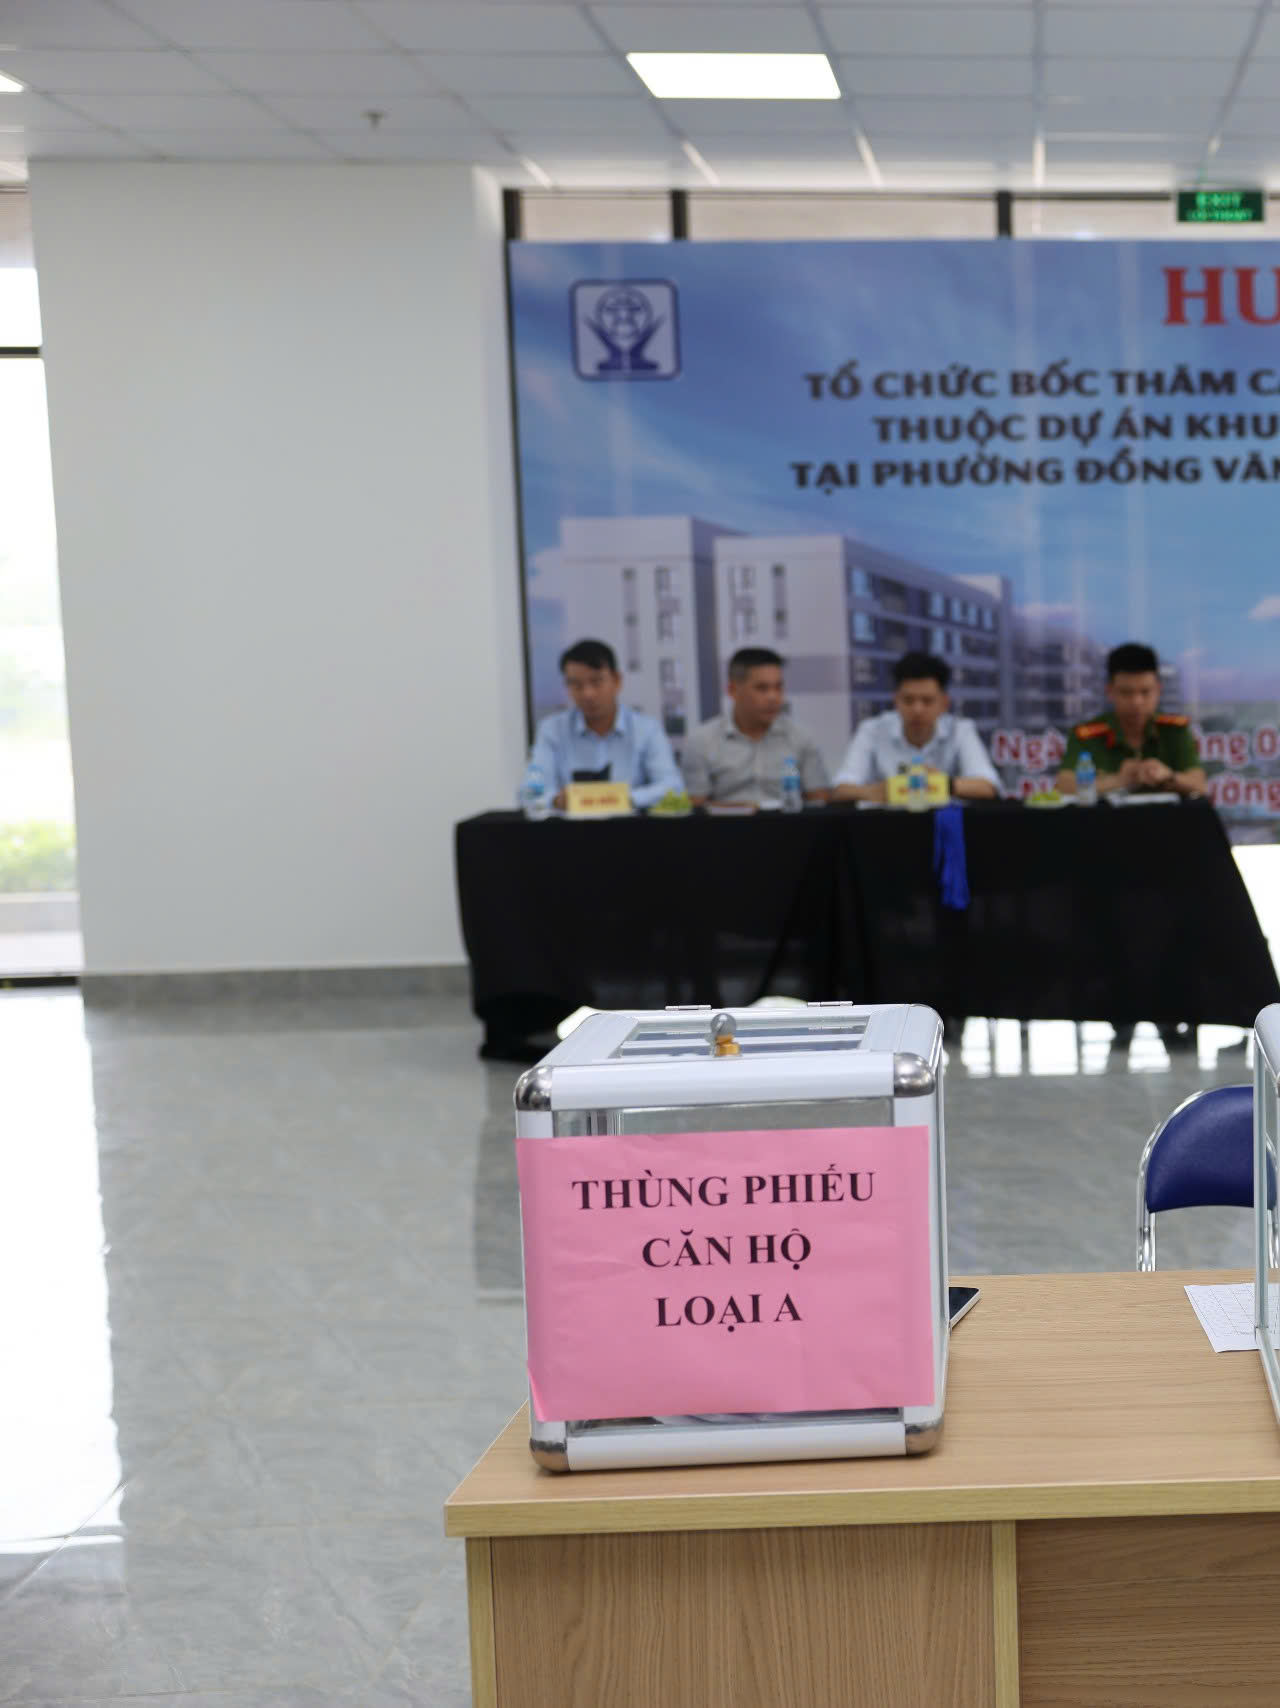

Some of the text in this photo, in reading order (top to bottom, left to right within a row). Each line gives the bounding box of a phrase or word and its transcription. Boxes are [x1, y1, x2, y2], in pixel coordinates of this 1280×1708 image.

[873, 363, 997, 399] CHỨC
[1009, 358, 1099, 398] BỐC
[1110, 363, 1236, 398] THĂM
[872, 407, 1026, 448] THUỘC
[1039, 409, 1104, 448] DỰ
[1113, 405, 1173, 441] ÁN
[1187, 412, 1279, 441] KHU
[790, 460, 859, 496] TẠI
[872, 451, 1064, 487] PHƯỜNG
[572, 1163, 876, 1211] THÙNG PHIẾU
[642, 1228, 812, 1271] CĂN HỘ
[655, 1293, 803, 1333] LOẠI A
